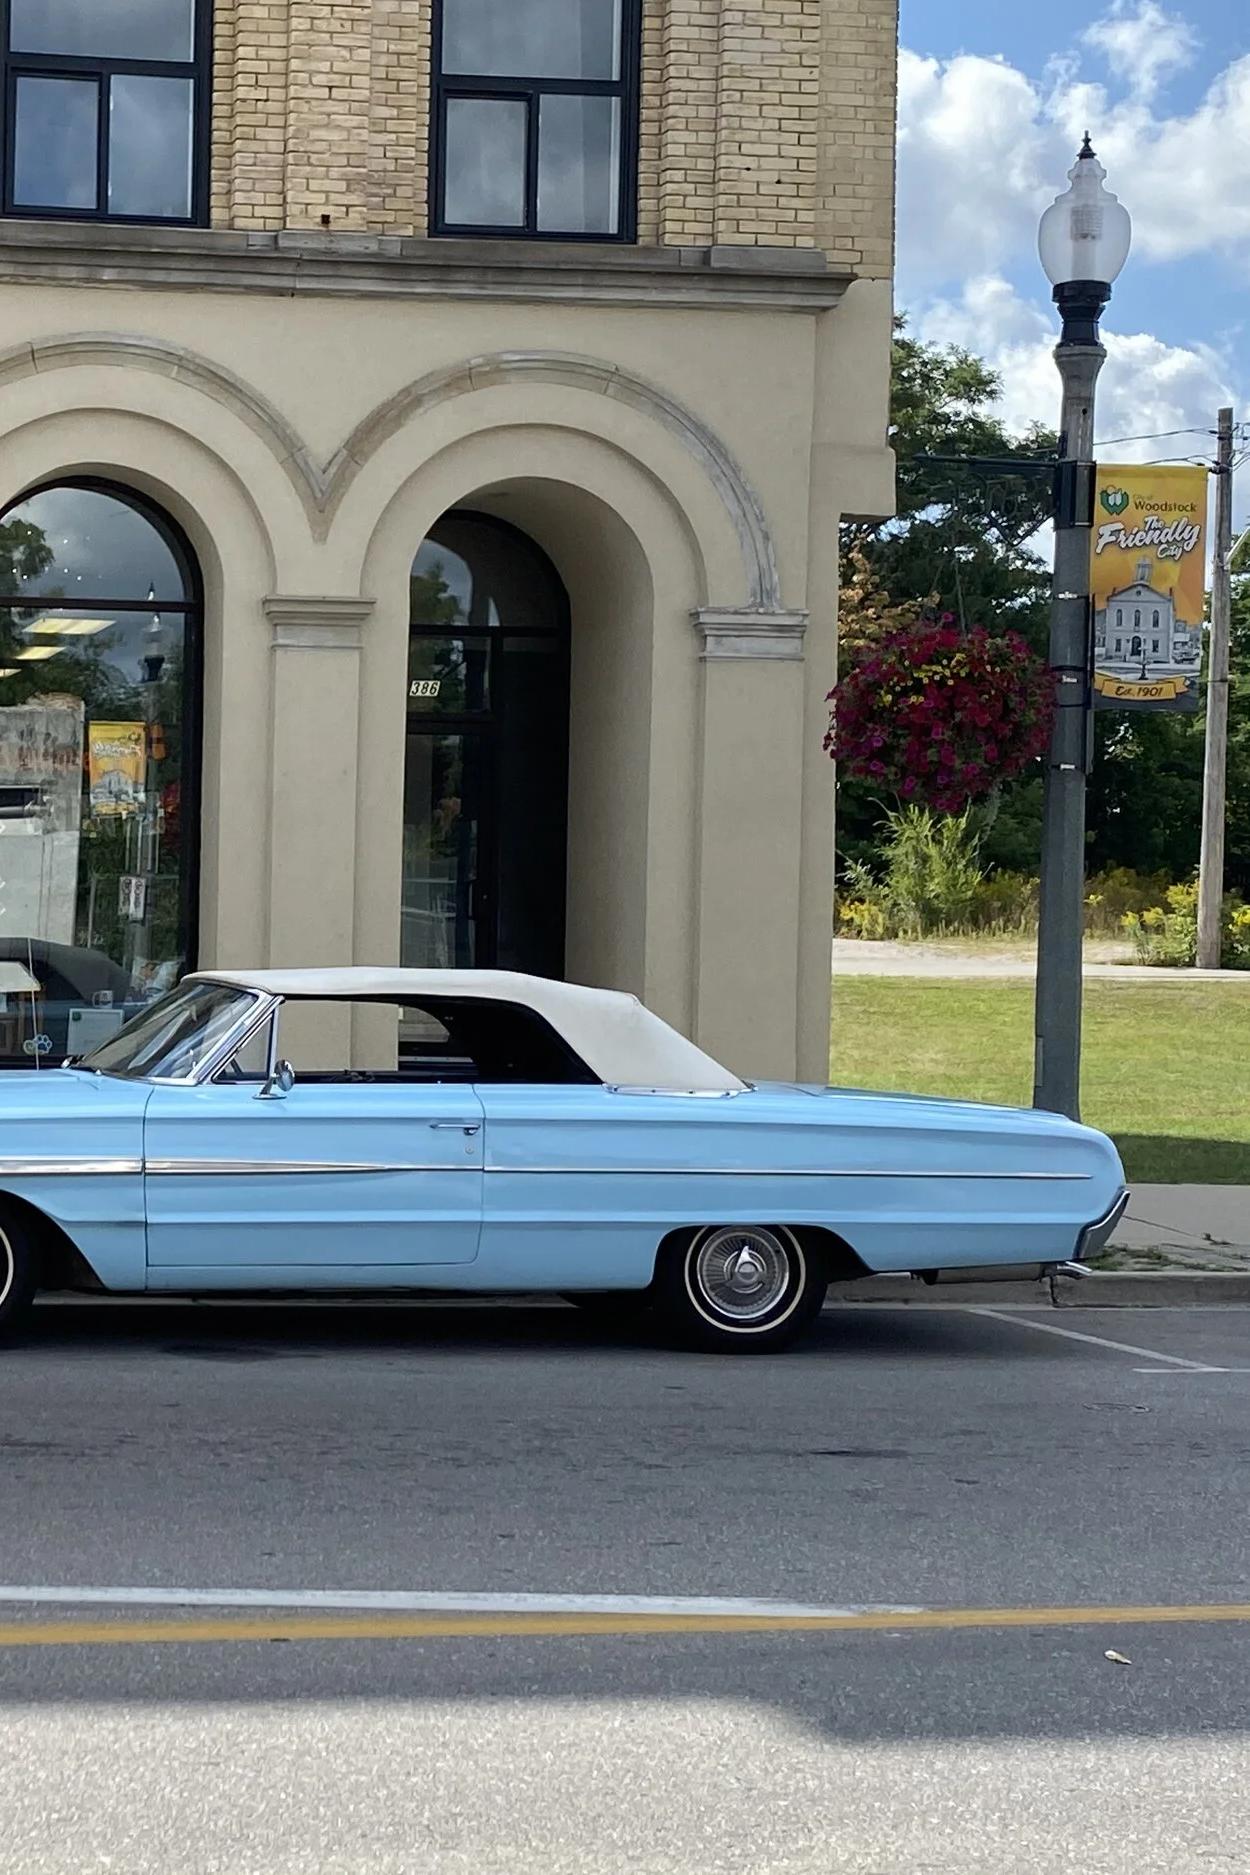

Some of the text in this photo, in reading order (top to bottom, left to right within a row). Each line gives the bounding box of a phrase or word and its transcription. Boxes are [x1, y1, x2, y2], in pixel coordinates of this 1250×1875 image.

[1134, 501, 1197, 512] Woodstock
[1144, 515, 1165, 531] The
[1095, 517, 1201, 554] Friendly
[1156, 544, 1183, 561] City
[411, 681, 438, 695] 386
[1137, 687, 1164, 697] 1901
